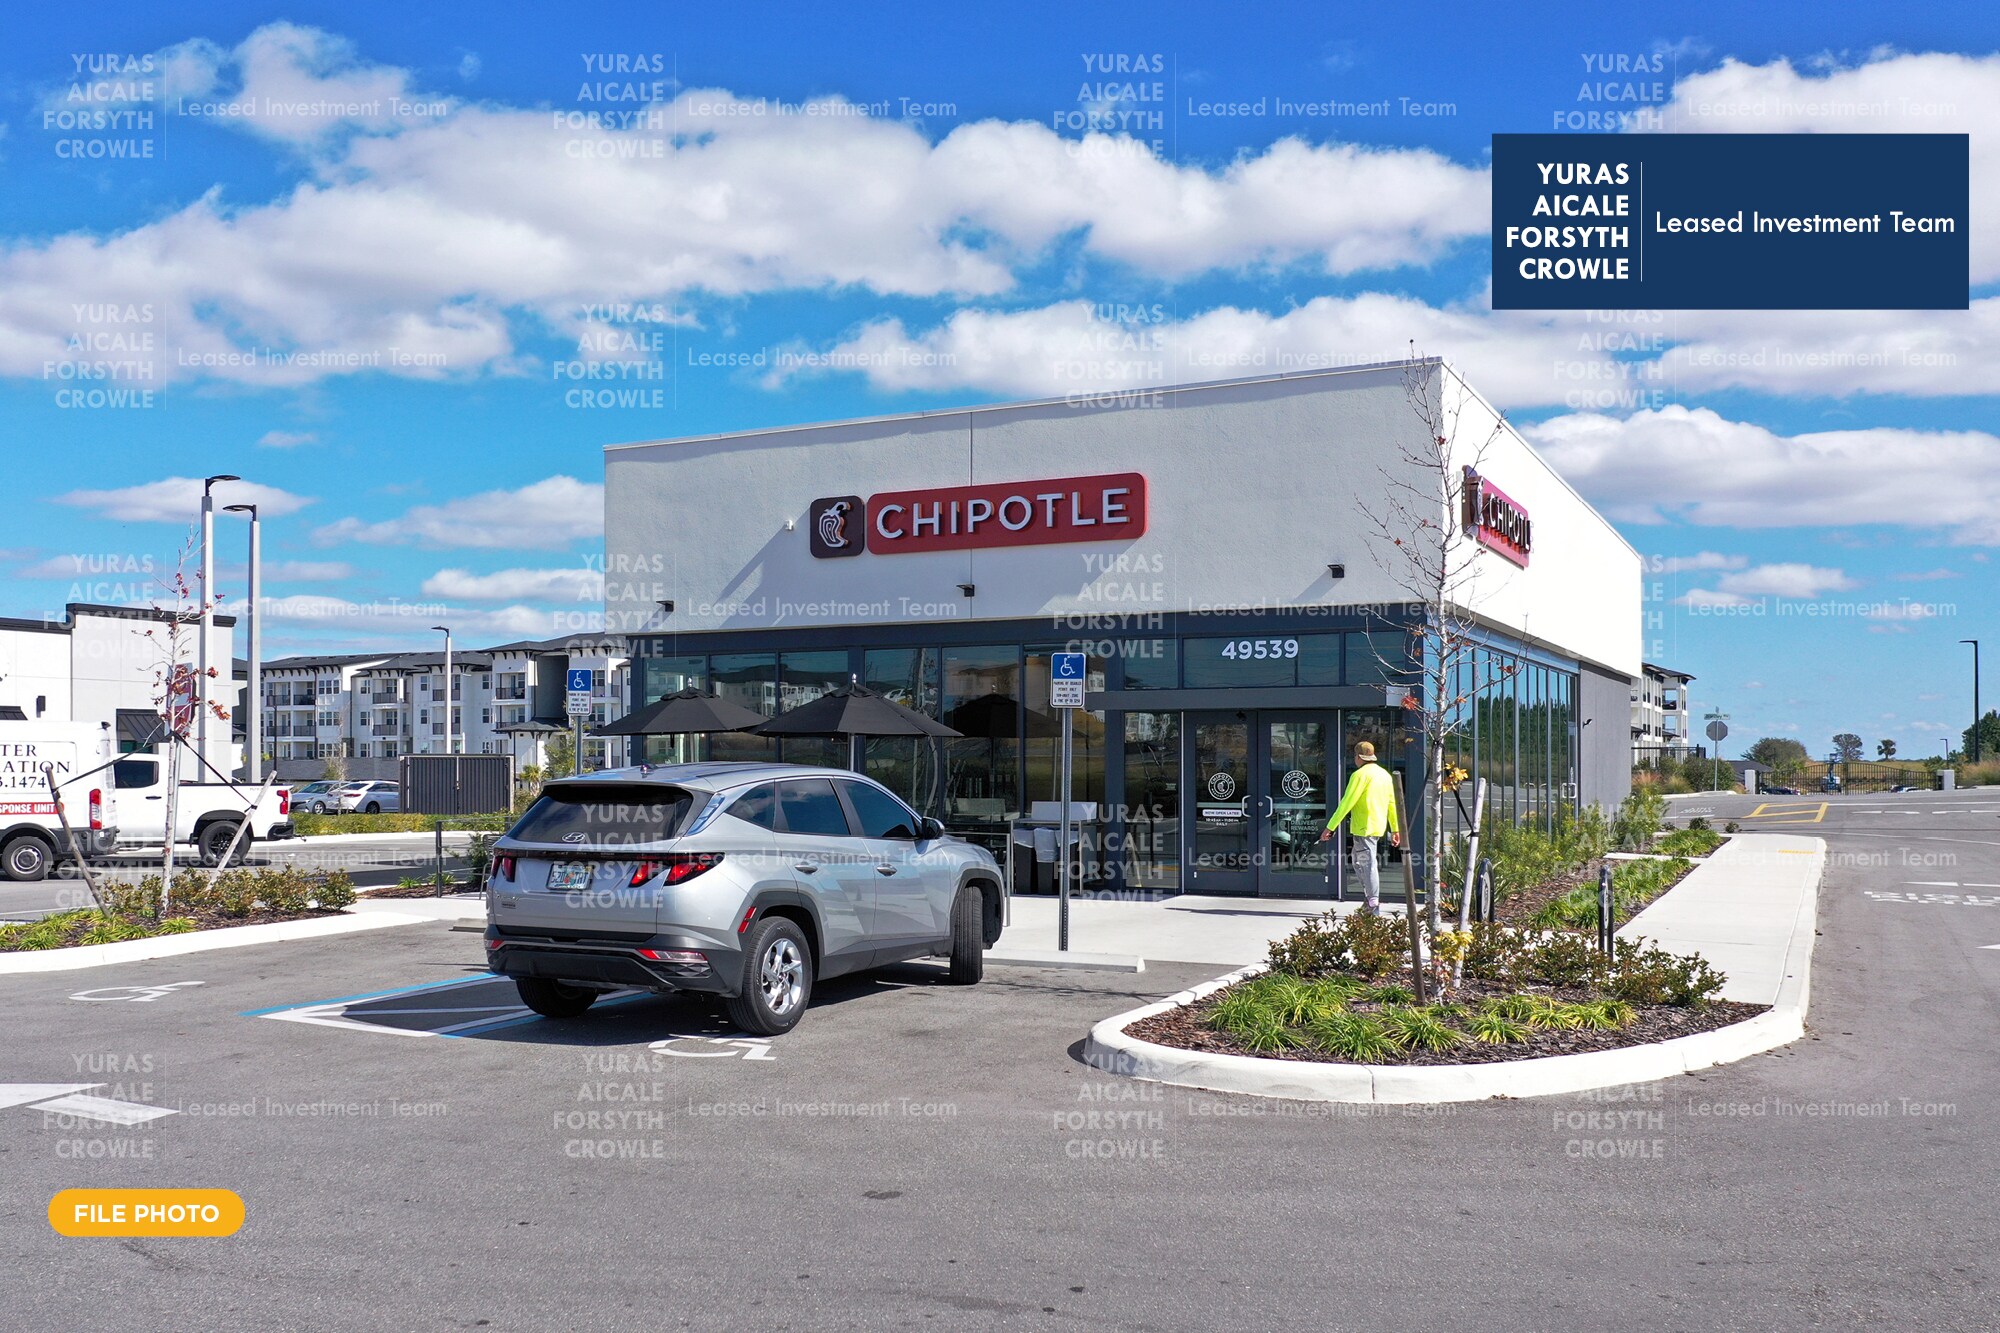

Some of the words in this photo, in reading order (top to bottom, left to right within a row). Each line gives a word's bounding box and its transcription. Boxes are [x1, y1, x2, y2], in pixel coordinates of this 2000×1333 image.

[876, 488, 1130, 539] CHIPOTLE
[1221, 639, 1299, 660] 49539
[0, 761, 70, 773] ATION
[34, 804, 55, 813] UNIT
